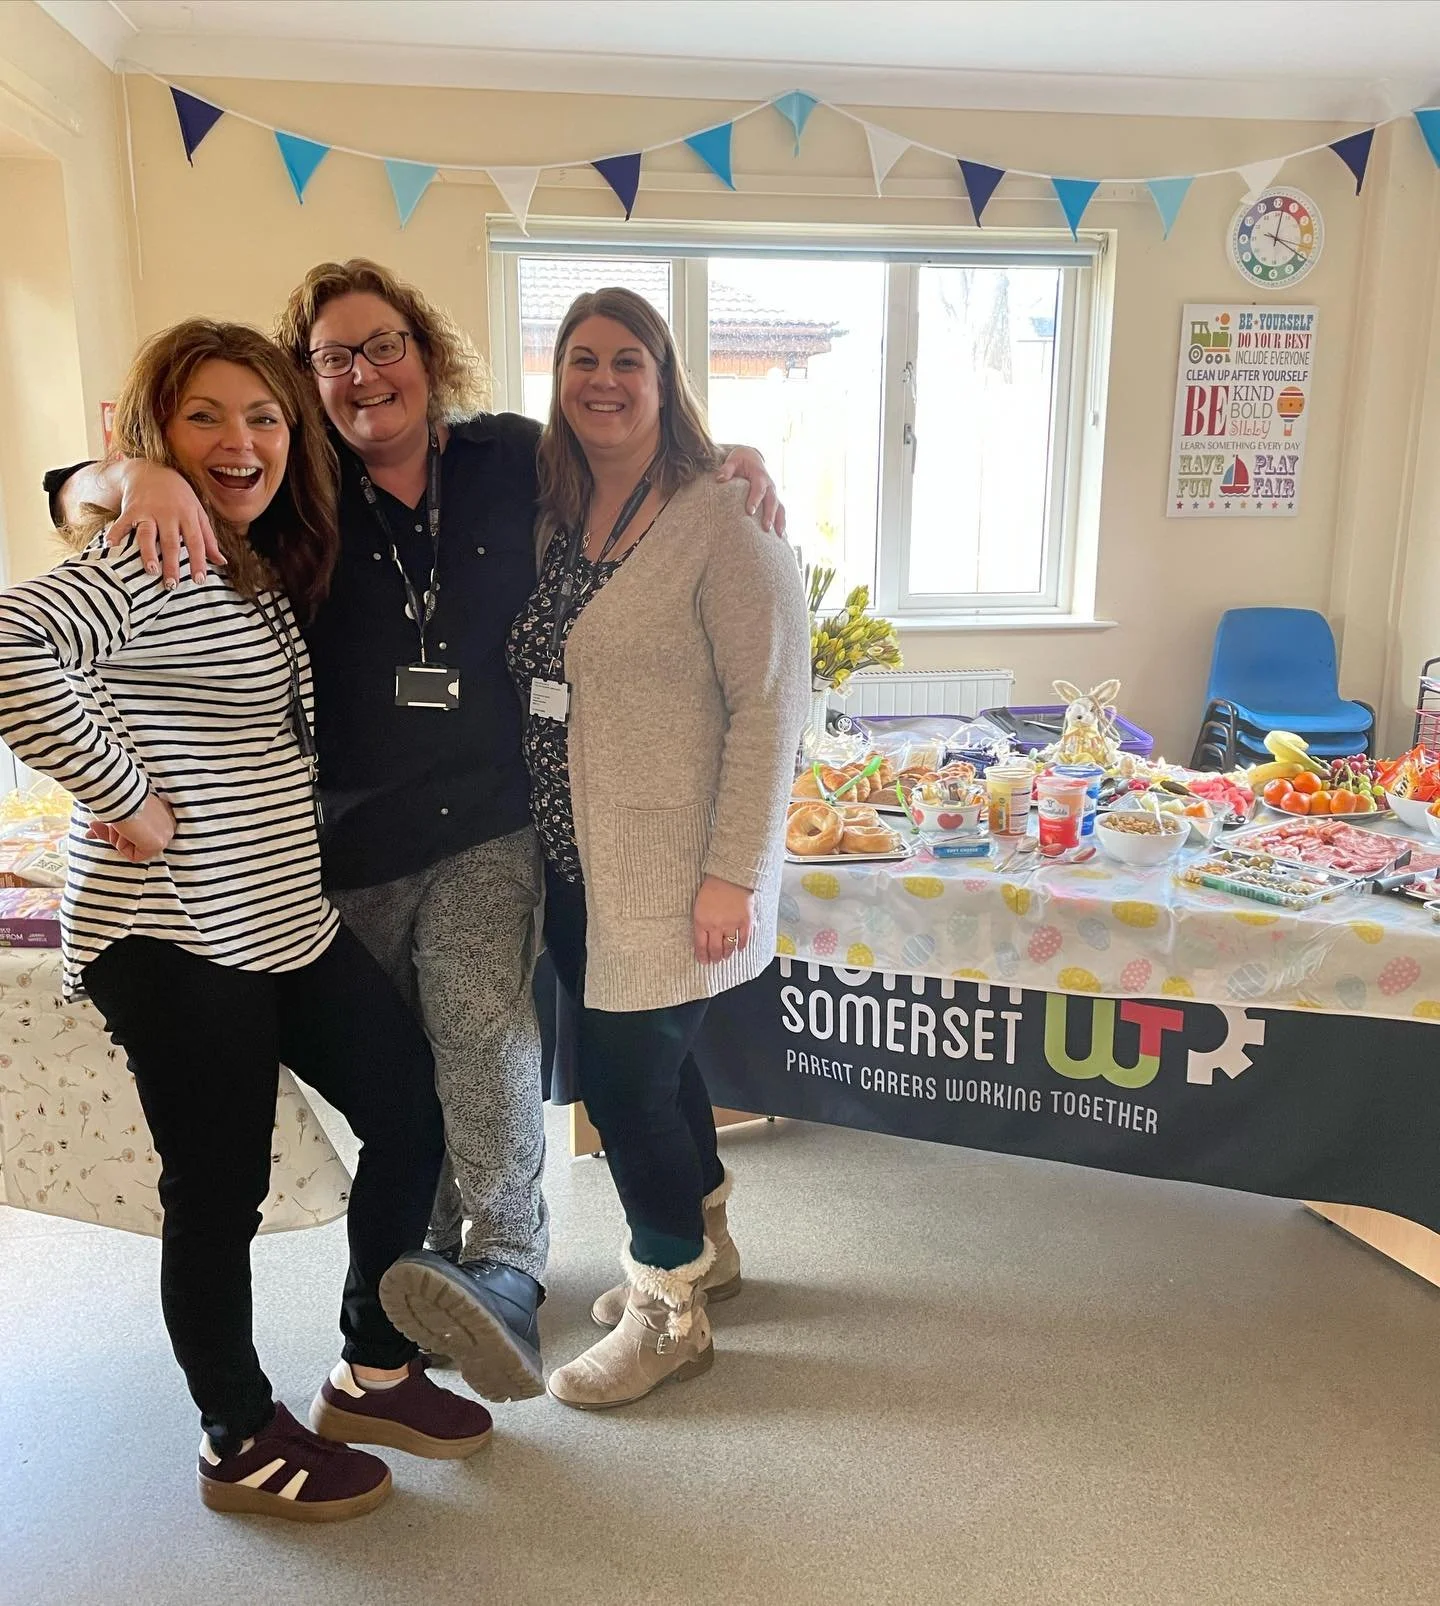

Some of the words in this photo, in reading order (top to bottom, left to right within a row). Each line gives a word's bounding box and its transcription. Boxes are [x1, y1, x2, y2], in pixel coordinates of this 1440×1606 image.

[1238, 313, 1253, 330] BE
[1259, 313, 1314, 331] YOURSELF
[1237, 333, 1251, 348] DO
[1254, 333, 1281, 349] YOUR
[1284, 333, 1312, 349] BEST
[1235, 350, 1269, 365] INCLUDE
[1270, 351, 1310, 365] EVERYONE
[1186, 369, 1216, 381] CLEAN
[1217, 369, 1230, 381] UP
[1231, 369, 1260, 382] AFTER
[1262, 370, 1308, 382] YOURSELF
[1232, 385, 1274, 401] KIND
[1182, 385, 1230, 436] BE
[1230, 402, 1273, 419] BOLD
[1229, 420, 1271, 439] SILLY
[1180, 441, 1206, 450] LEARN
[1207, 441, 1257, 450] SOMETHING
[1257, 441, 1283, 450] EVERY
[1284, 442, 1301, 451] DAY
[1178, 454, 1225, 476] HAVE
[1253, 454, 1299, 476] PLAY
[1176, 477, 1212, 499] FUN
[1251, 477, 1296, 499] FAIR
[780, 985, 1023, 1065] SOMERSET
[786, 1049, 853, 1084] PARENT
[860, 1066, 937, 1100] CARERS
[945, 1078, 1042, 1112] WORKING
[1050, 1091, 1159, 1135] TOGETHER
